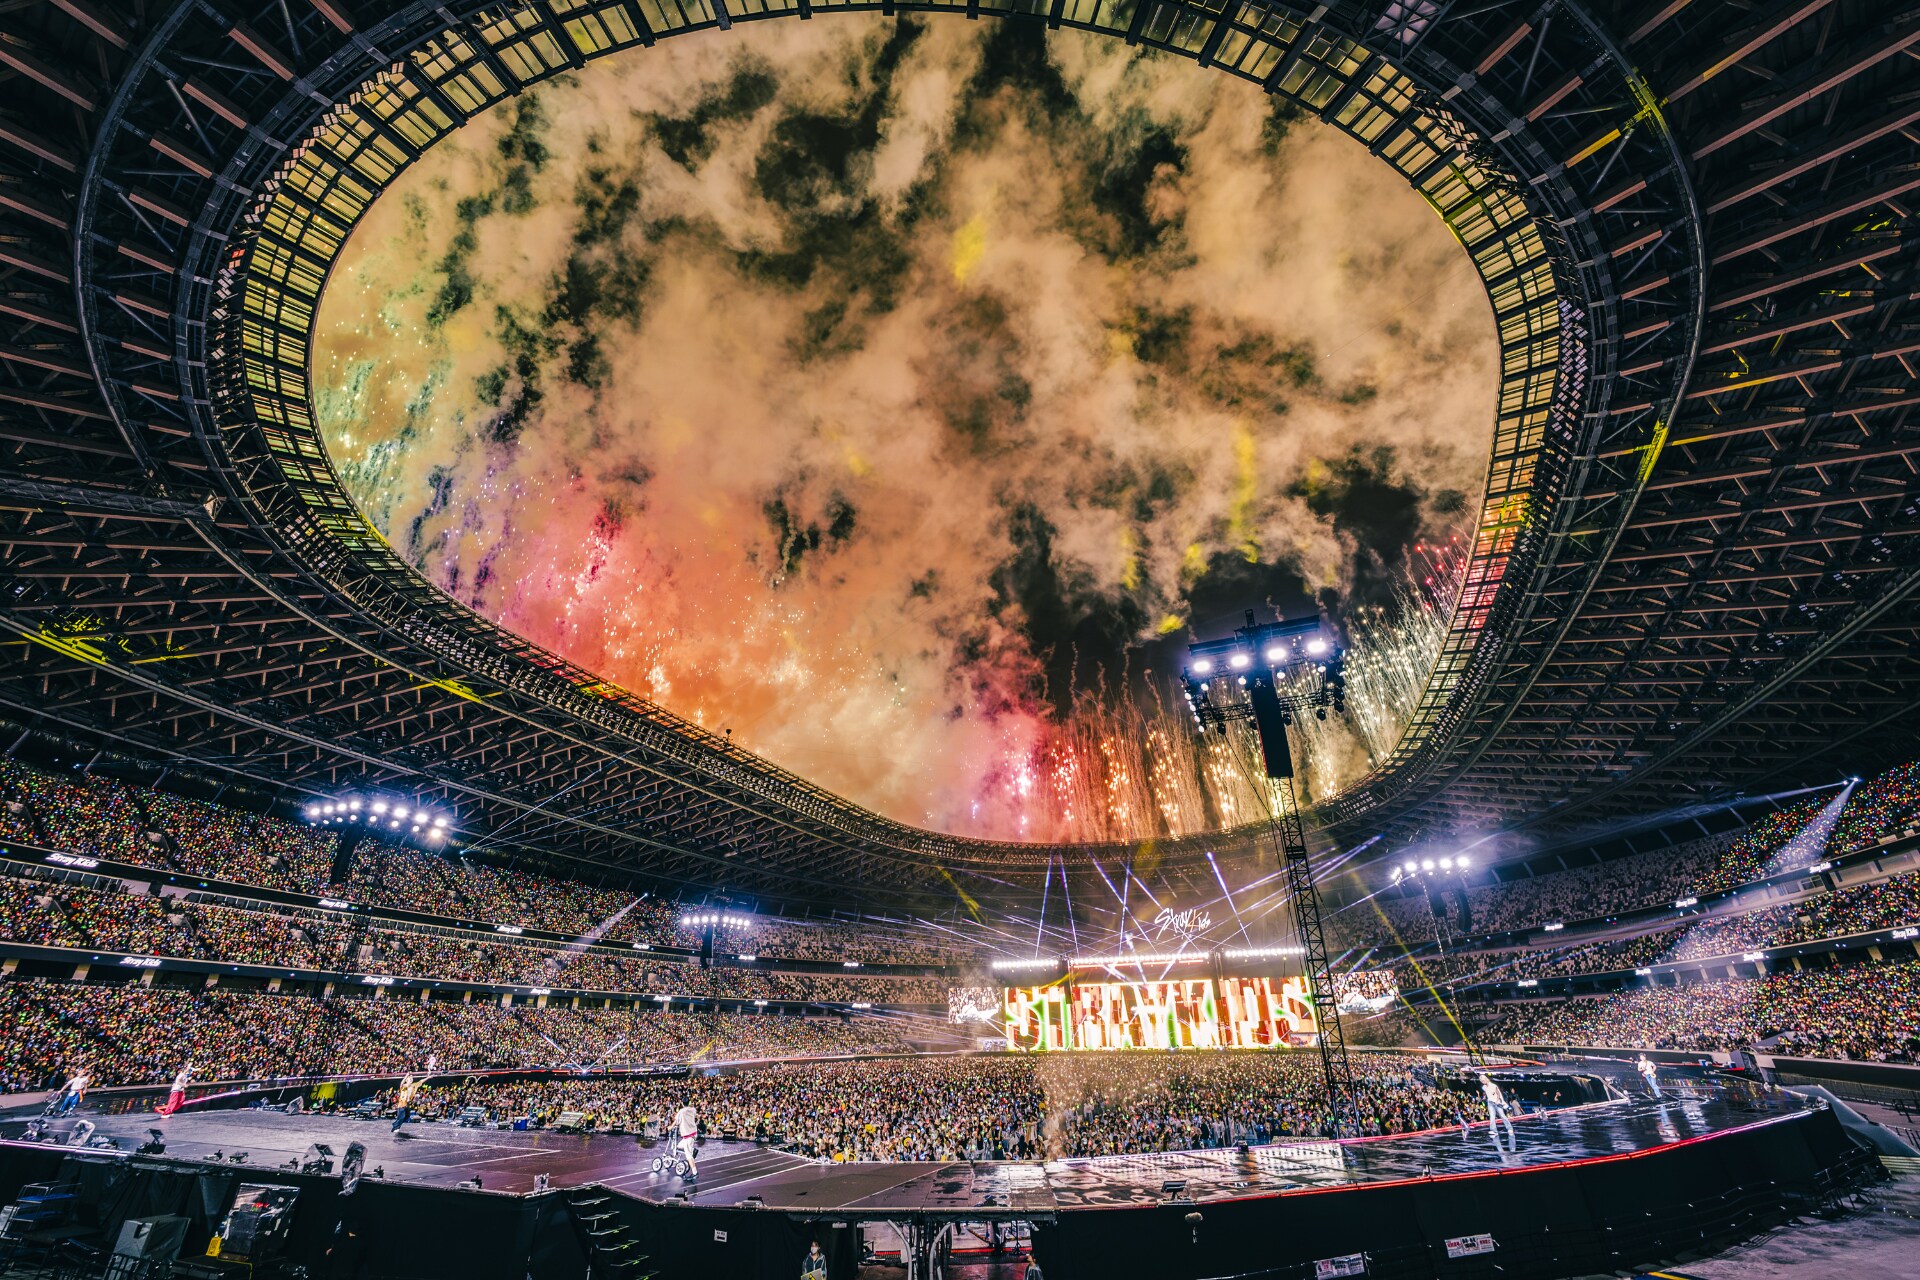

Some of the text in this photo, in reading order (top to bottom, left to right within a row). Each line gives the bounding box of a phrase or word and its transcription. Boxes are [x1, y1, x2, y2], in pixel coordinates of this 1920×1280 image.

[45, 852, 99, 868] Stray Kids
[119, 957, 162, 967] Stray Kids
